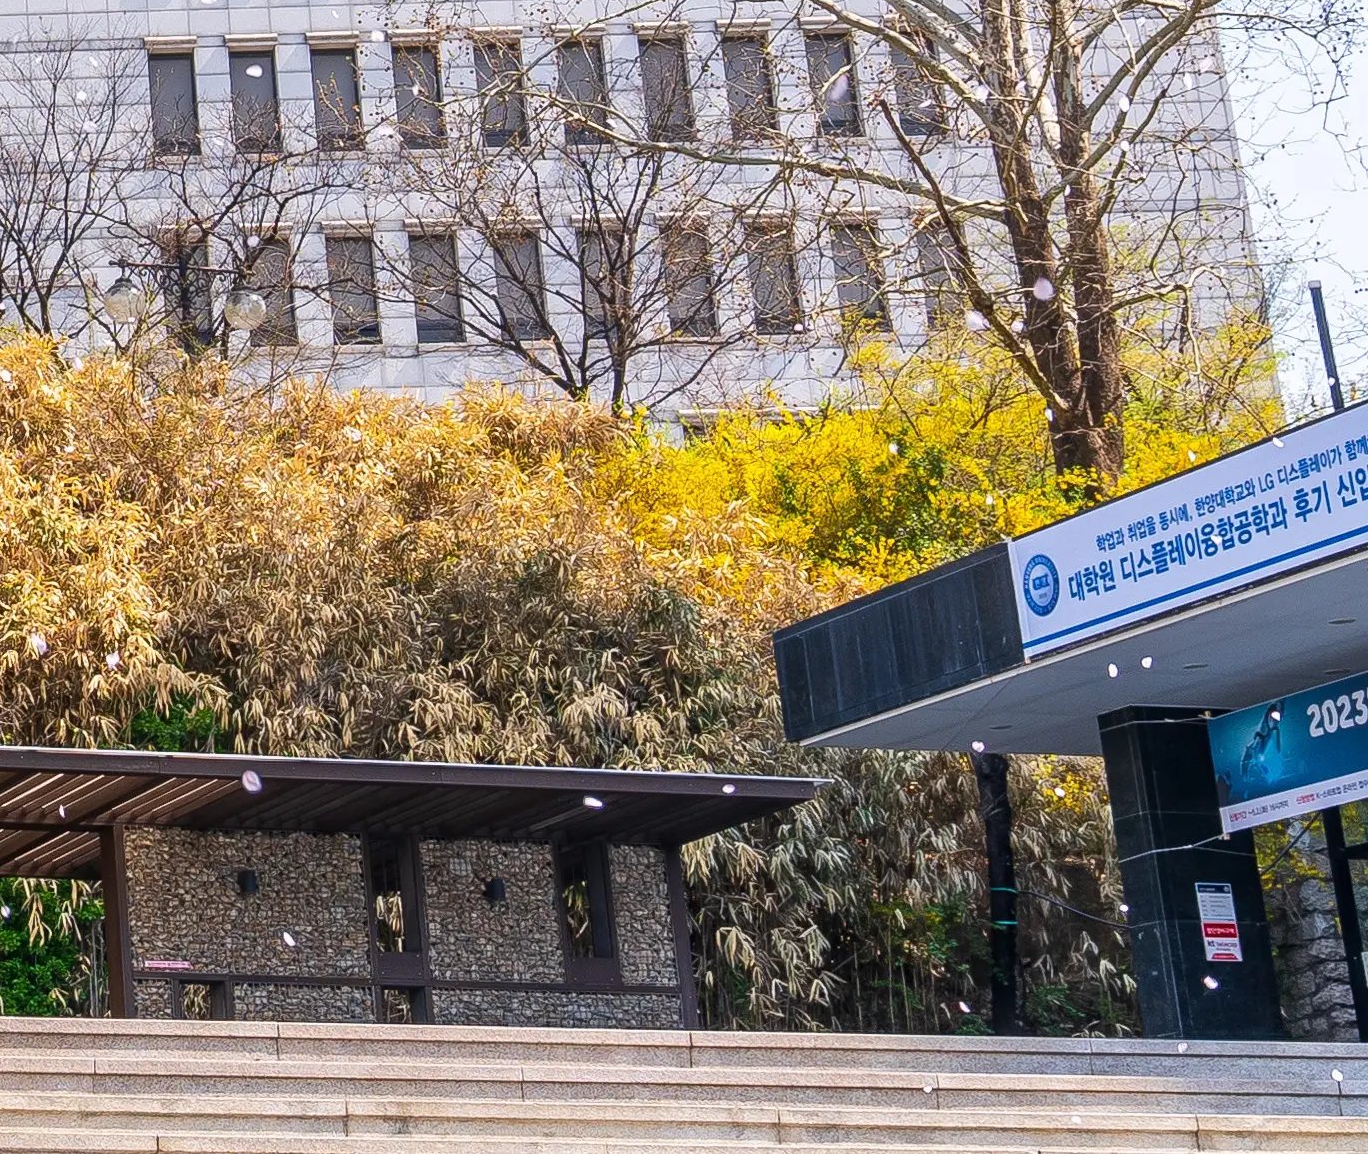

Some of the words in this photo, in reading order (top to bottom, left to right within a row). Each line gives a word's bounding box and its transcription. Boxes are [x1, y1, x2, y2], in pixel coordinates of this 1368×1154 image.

[1068, 559, 1116, 601] 대학원
[1119, 496, 1288, 583] 디스플레이융합공학과
[1293, 480, 1332, 522] 후기
[1096, 527, 1125, 552] 학업과
[1127, 516, 1157, 542] 취업을
[1159, 503, 1193, 531] 동시에,
[1194, 478, 1256, 517] 한양대학교와
[1258, 473, 1275, 493] LG
[1277, 446, 1342, 485] 디스플레이가
[1344, 434, 1368, 462] 함께
[1306, 689, 1368, 738] 2023
